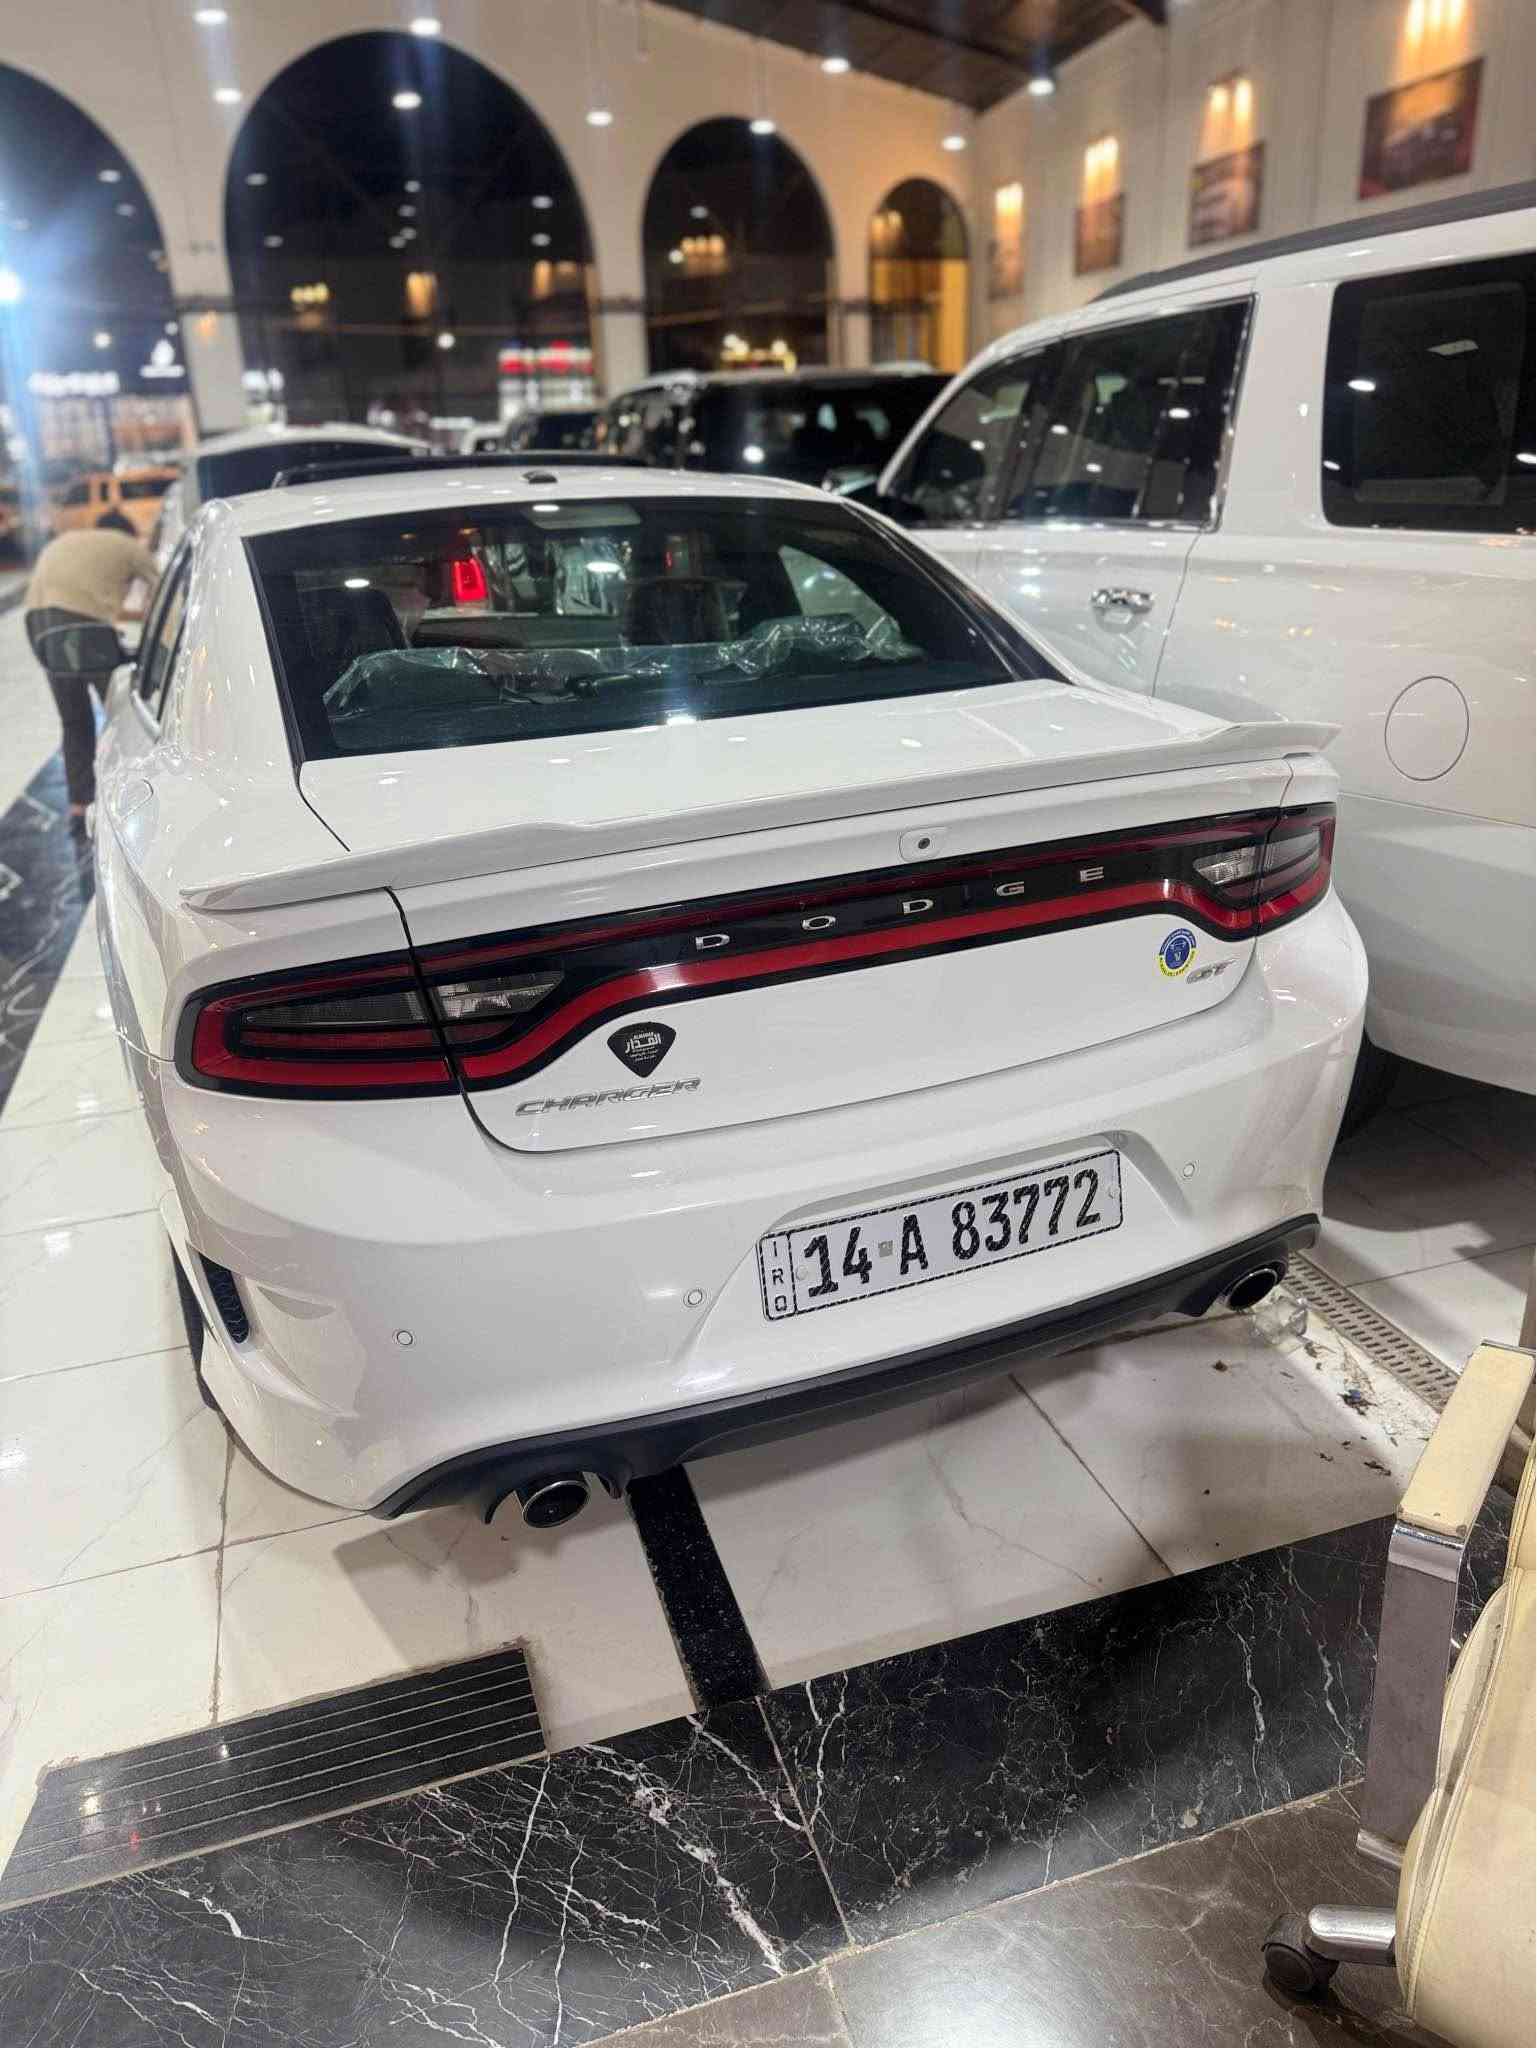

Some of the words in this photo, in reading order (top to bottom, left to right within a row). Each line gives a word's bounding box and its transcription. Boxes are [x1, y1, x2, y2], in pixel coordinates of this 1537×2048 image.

[695, 866, 1105, 951] DODGE
[1186, 959, 1237, 984] GT
[515, 1078, 702, 1116] CHARGER
[803, 1226, 873, 1298] 14
[900, 1213, 929, 1276] A
[951, 1168, 1102, 1261] 83772
